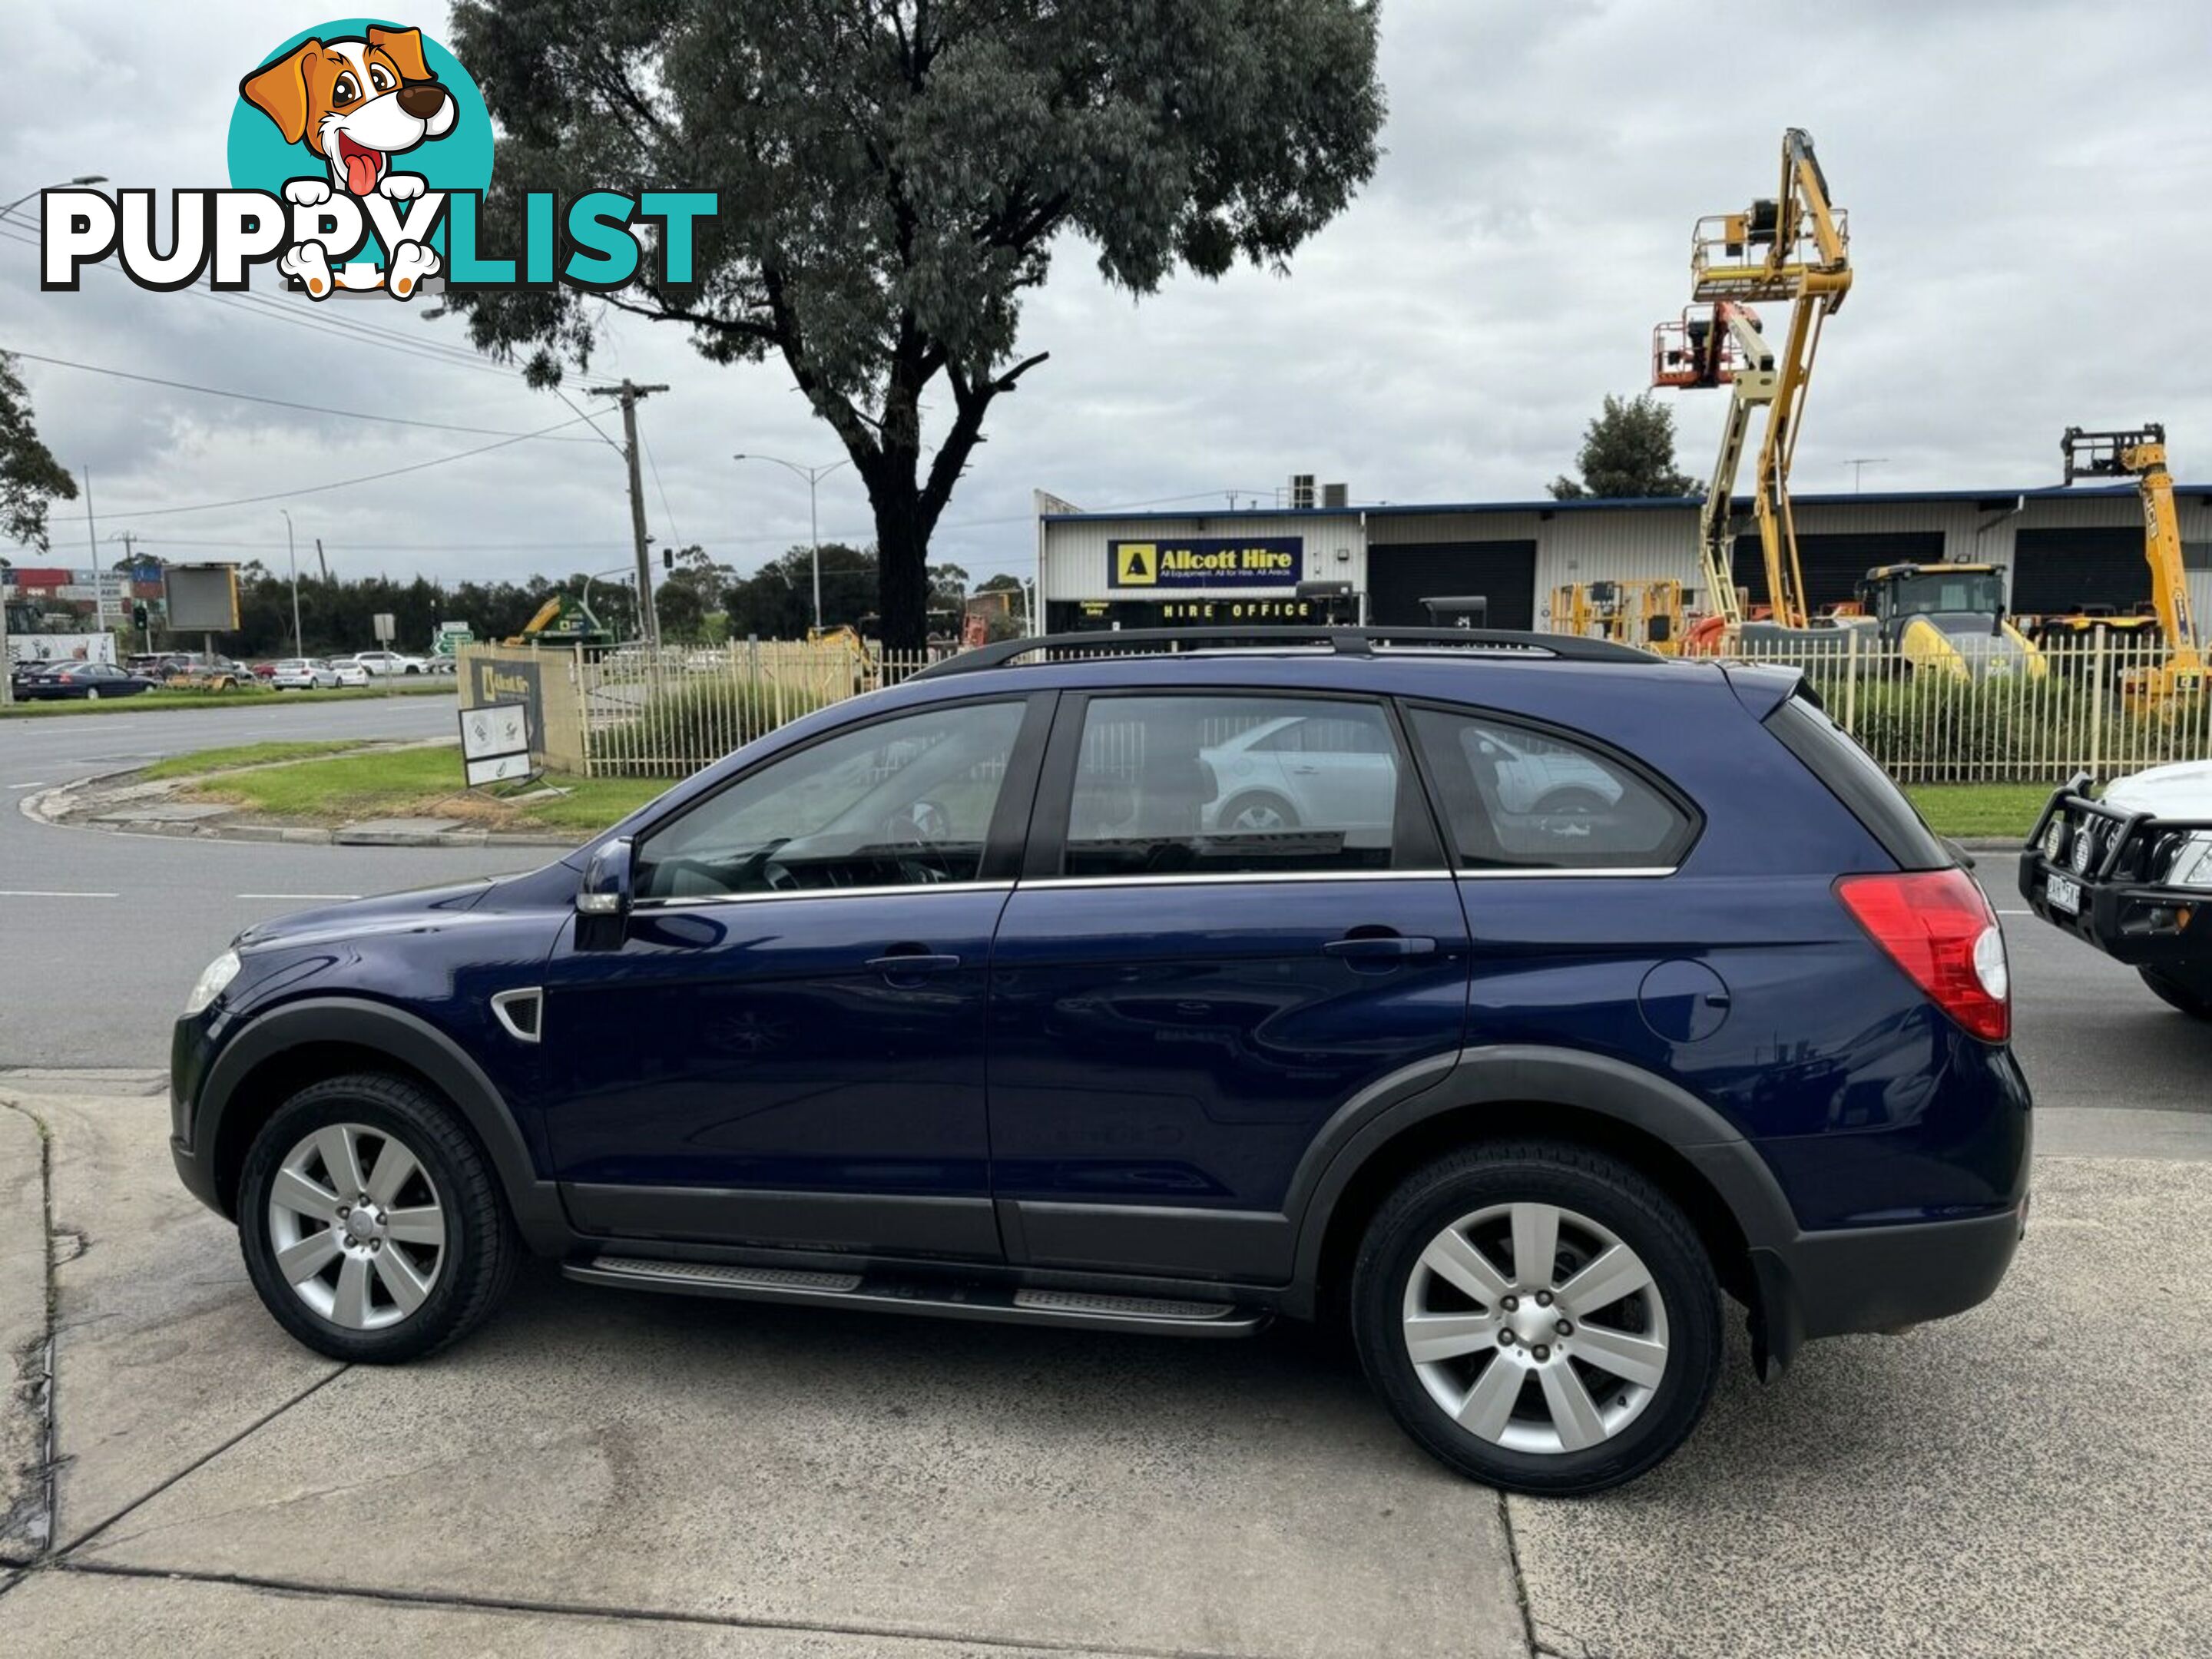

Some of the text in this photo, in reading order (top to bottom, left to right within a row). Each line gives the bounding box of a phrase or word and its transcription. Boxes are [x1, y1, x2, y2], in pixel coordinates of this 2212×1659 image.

[1161, 548, 1292, 569] Allcott Hire
[1164, 603, 1309, 618] HIRE OFFICE
